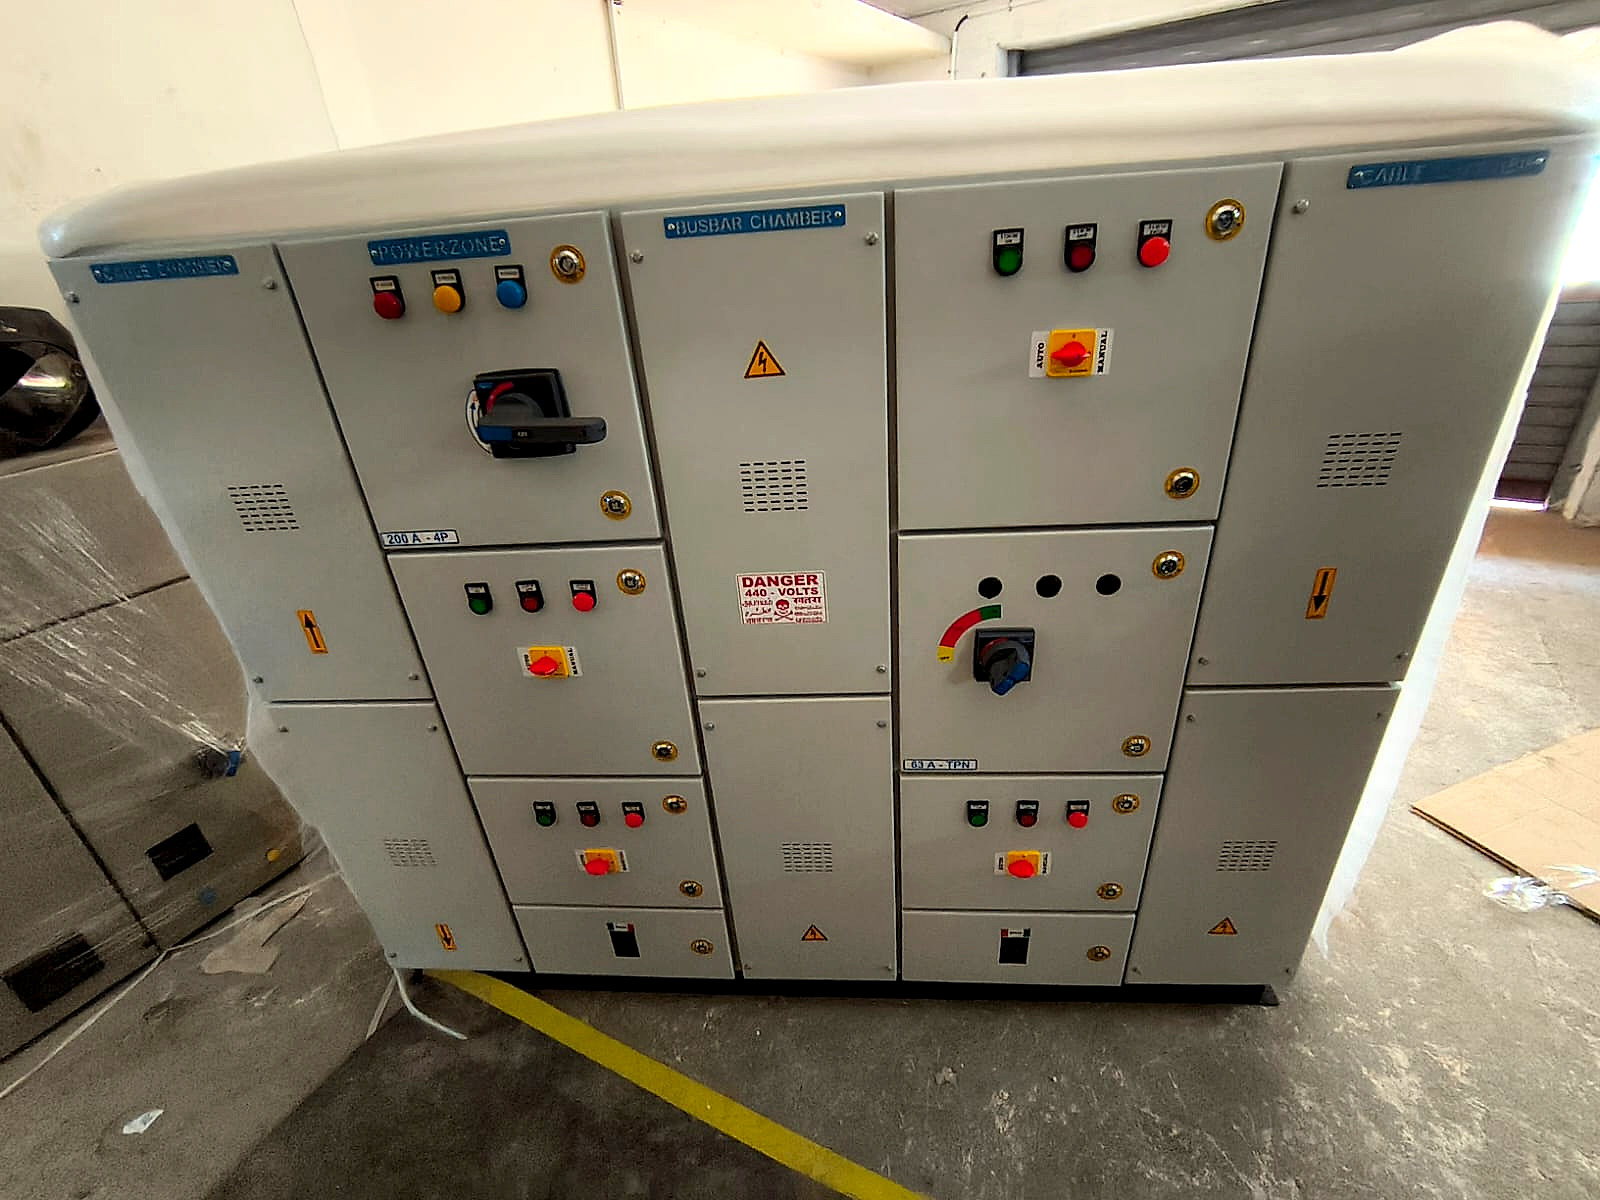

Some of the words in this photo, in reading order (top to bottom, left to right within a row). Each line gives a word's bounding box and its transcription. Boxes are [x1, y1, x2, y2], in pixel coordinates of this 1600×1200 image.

[675, 216, 742, 236] BUSBAR
[750, 209, 833, 229] CHAMBER
[377, 235, 502, 261] POWERZONE
[1036, 342, 1045, 369] AUTO
[1097, 330, 1108, 374] MANUAL
[387, 534, 409, 544] 200
[412, 532, 422, 544] A
[434, 532, 449, 542] 4P
[741, 574, 819, 588] DANGER
[745, 588, 768, 597] 440
[778, 587, 819, 597] VOLTS
[927, 761, 936, 769] A
[948, 760, 970, 769] TPN
